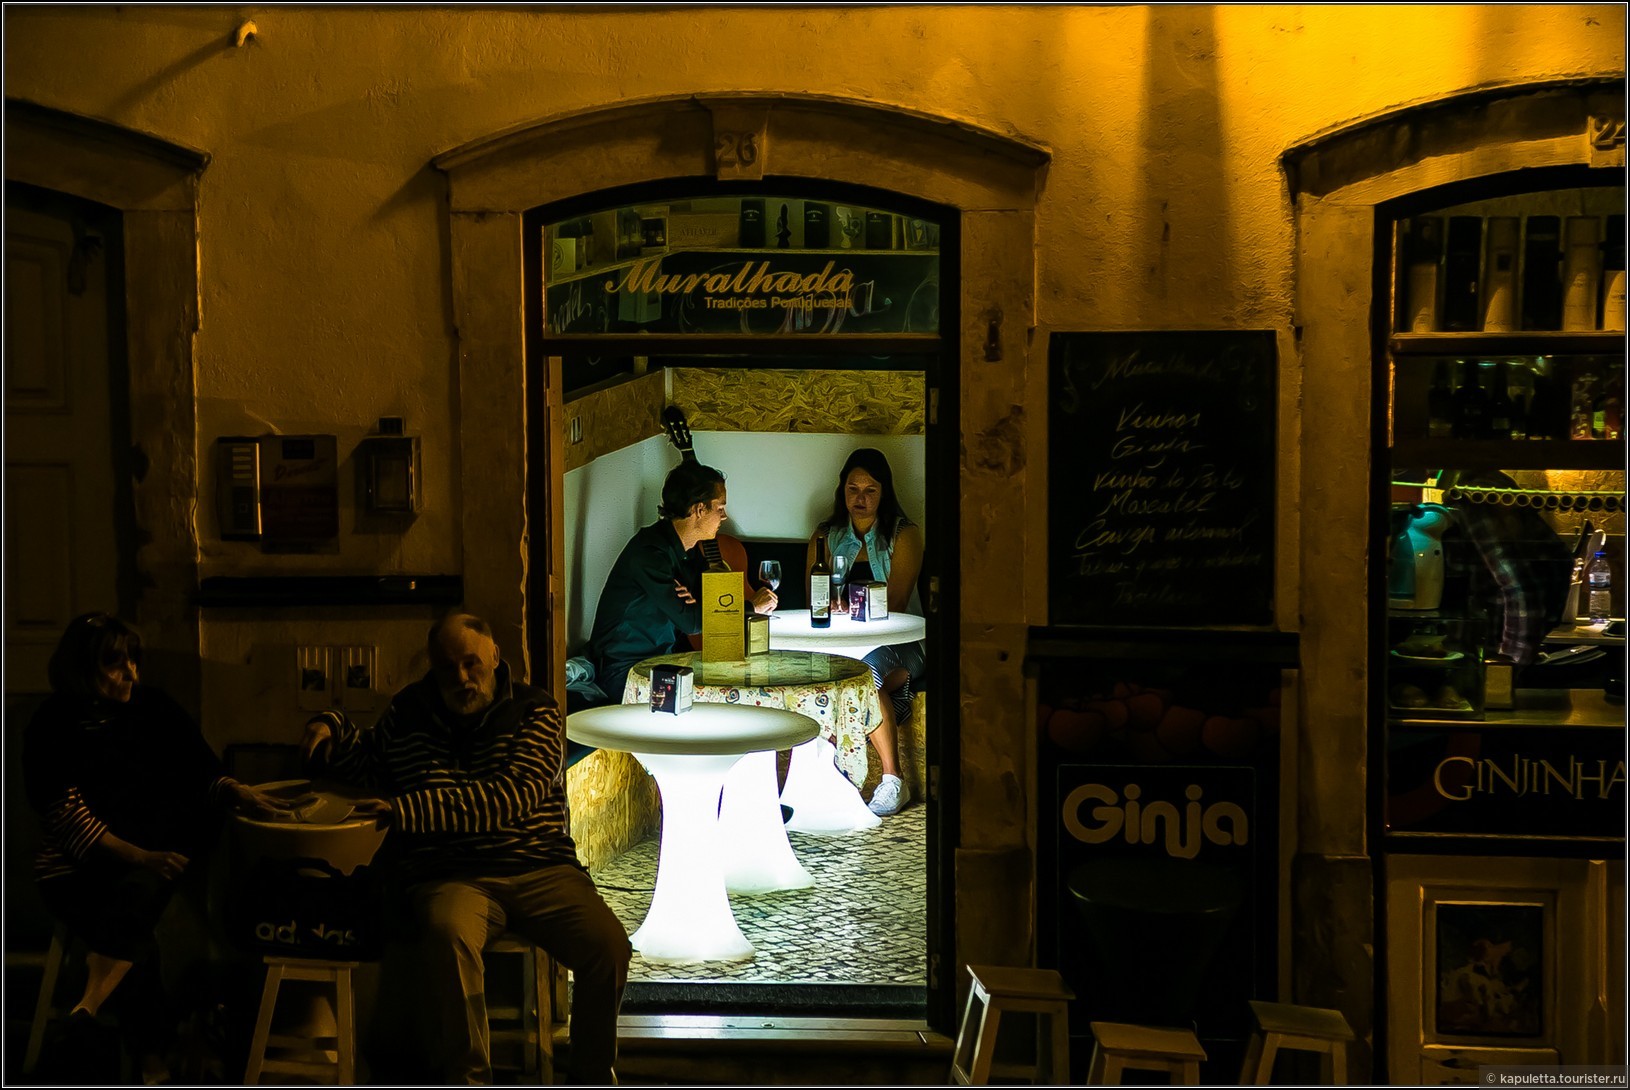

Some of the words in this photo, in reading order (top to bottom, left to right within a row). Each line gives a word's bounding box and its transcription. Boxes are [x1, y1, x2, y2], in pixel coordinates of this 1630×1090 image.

[714, 131, 759, 168] 26
[605, 260, 856, 295] Muralhada
[704, 296, 767, 311] Tradições
[1116, 402, 1201, 432] Vinhos
[1093, 468, 1157, 492] Vinho
[1096, 488, 1217, 517] Moscatel
[1432, 753, 1626, 801] GINJINHA
[1062, 783, 1249, 860] Ginja
